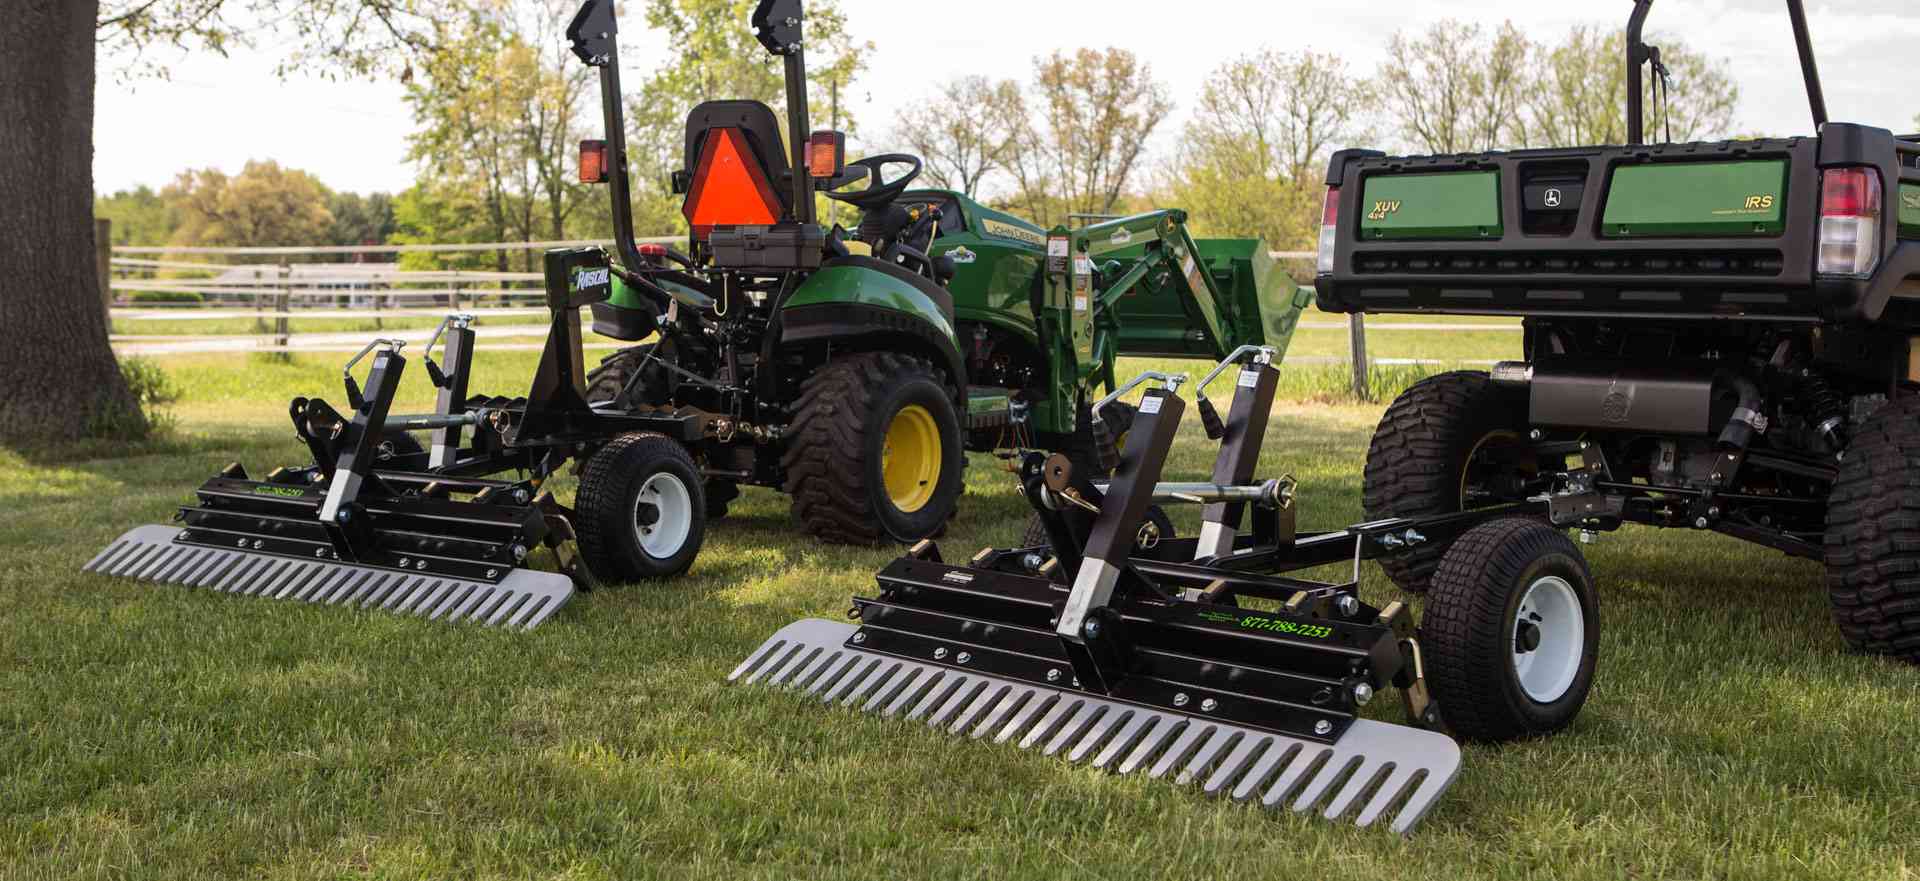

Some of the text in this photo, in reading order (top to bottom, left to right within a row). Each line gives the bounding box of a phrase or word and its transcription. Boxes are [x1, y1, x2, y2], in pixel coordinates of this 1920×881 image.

[1376, 200, 1400, 212] XUV
[1745, 195, 1773, 209] IRS
[992, 223, 1040, 242] JOHN DEERE
[576, 269, 609, 290] RASCAL
[1240, 616, 1332, 638] 877-788-7253
